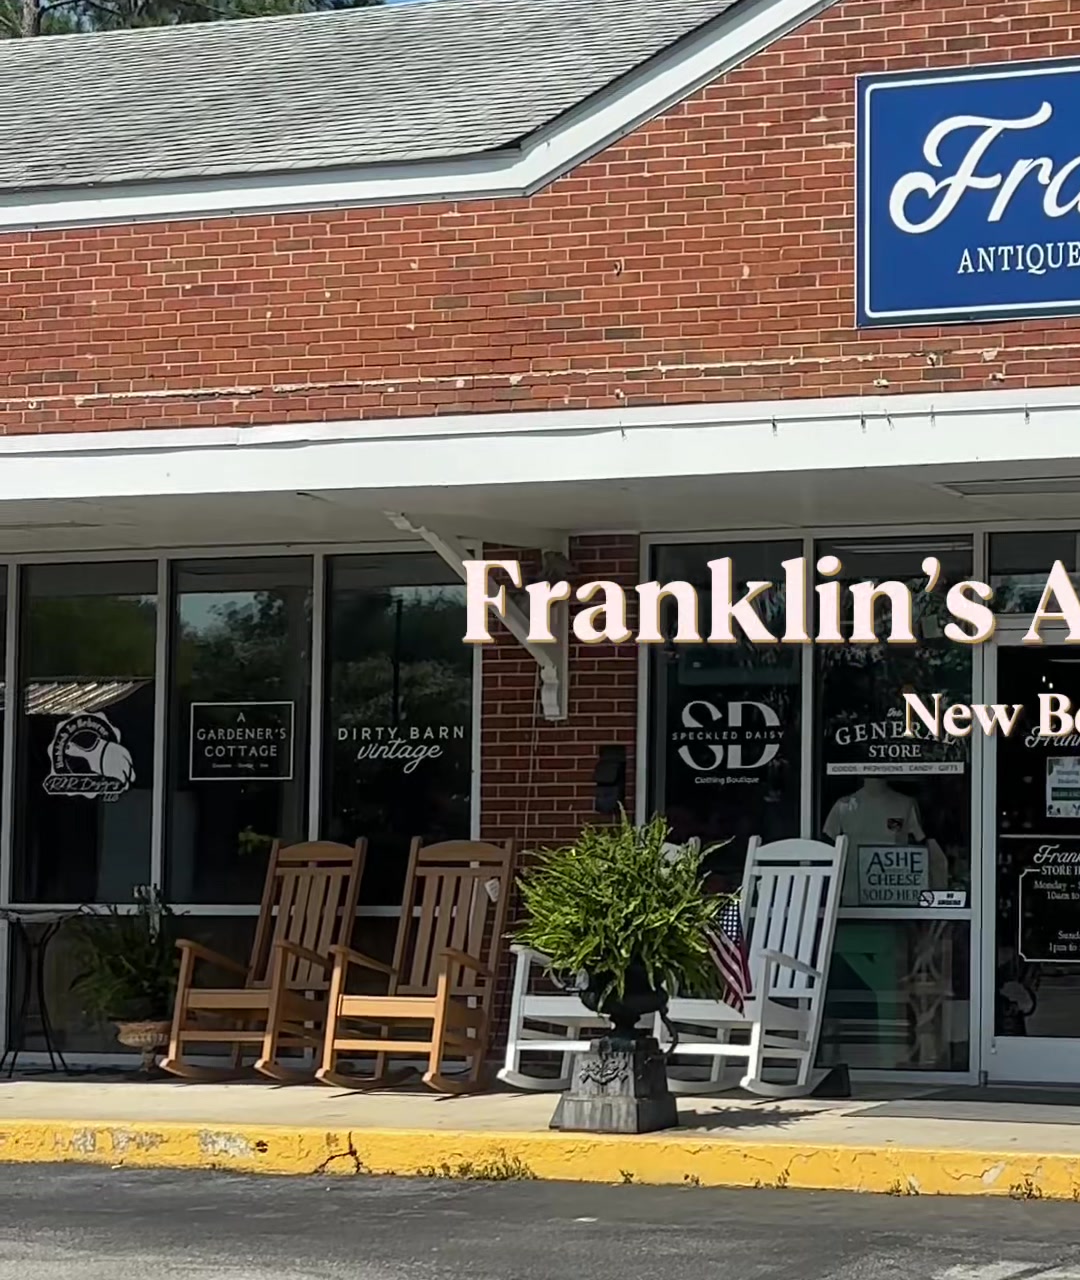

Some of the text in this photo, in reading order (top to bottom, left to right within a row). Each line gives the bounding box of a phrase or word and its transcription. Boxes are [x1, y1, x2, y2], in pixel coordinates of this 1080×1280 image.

[237, 712, 246, 722] A
[196, 728, 287, 740] GARDENER'S
[337, 725, 465, 741] DIRTY BARN
[671, 730, 785, 740] SPECKLED DAISY
[204, 745, 278, 757] COTTAGE
[357, 738, 444, 774] vintage
[868, 744, 922, 758] STORE
[866, 851, 924, 875] ASHE
[1041, 865, 1072, 876] STORE
[867, 873, 921, 886] CHEESE
[1033, 881, 1068, 892] Monday
[863, 889, 920, 901] SOLD HER
